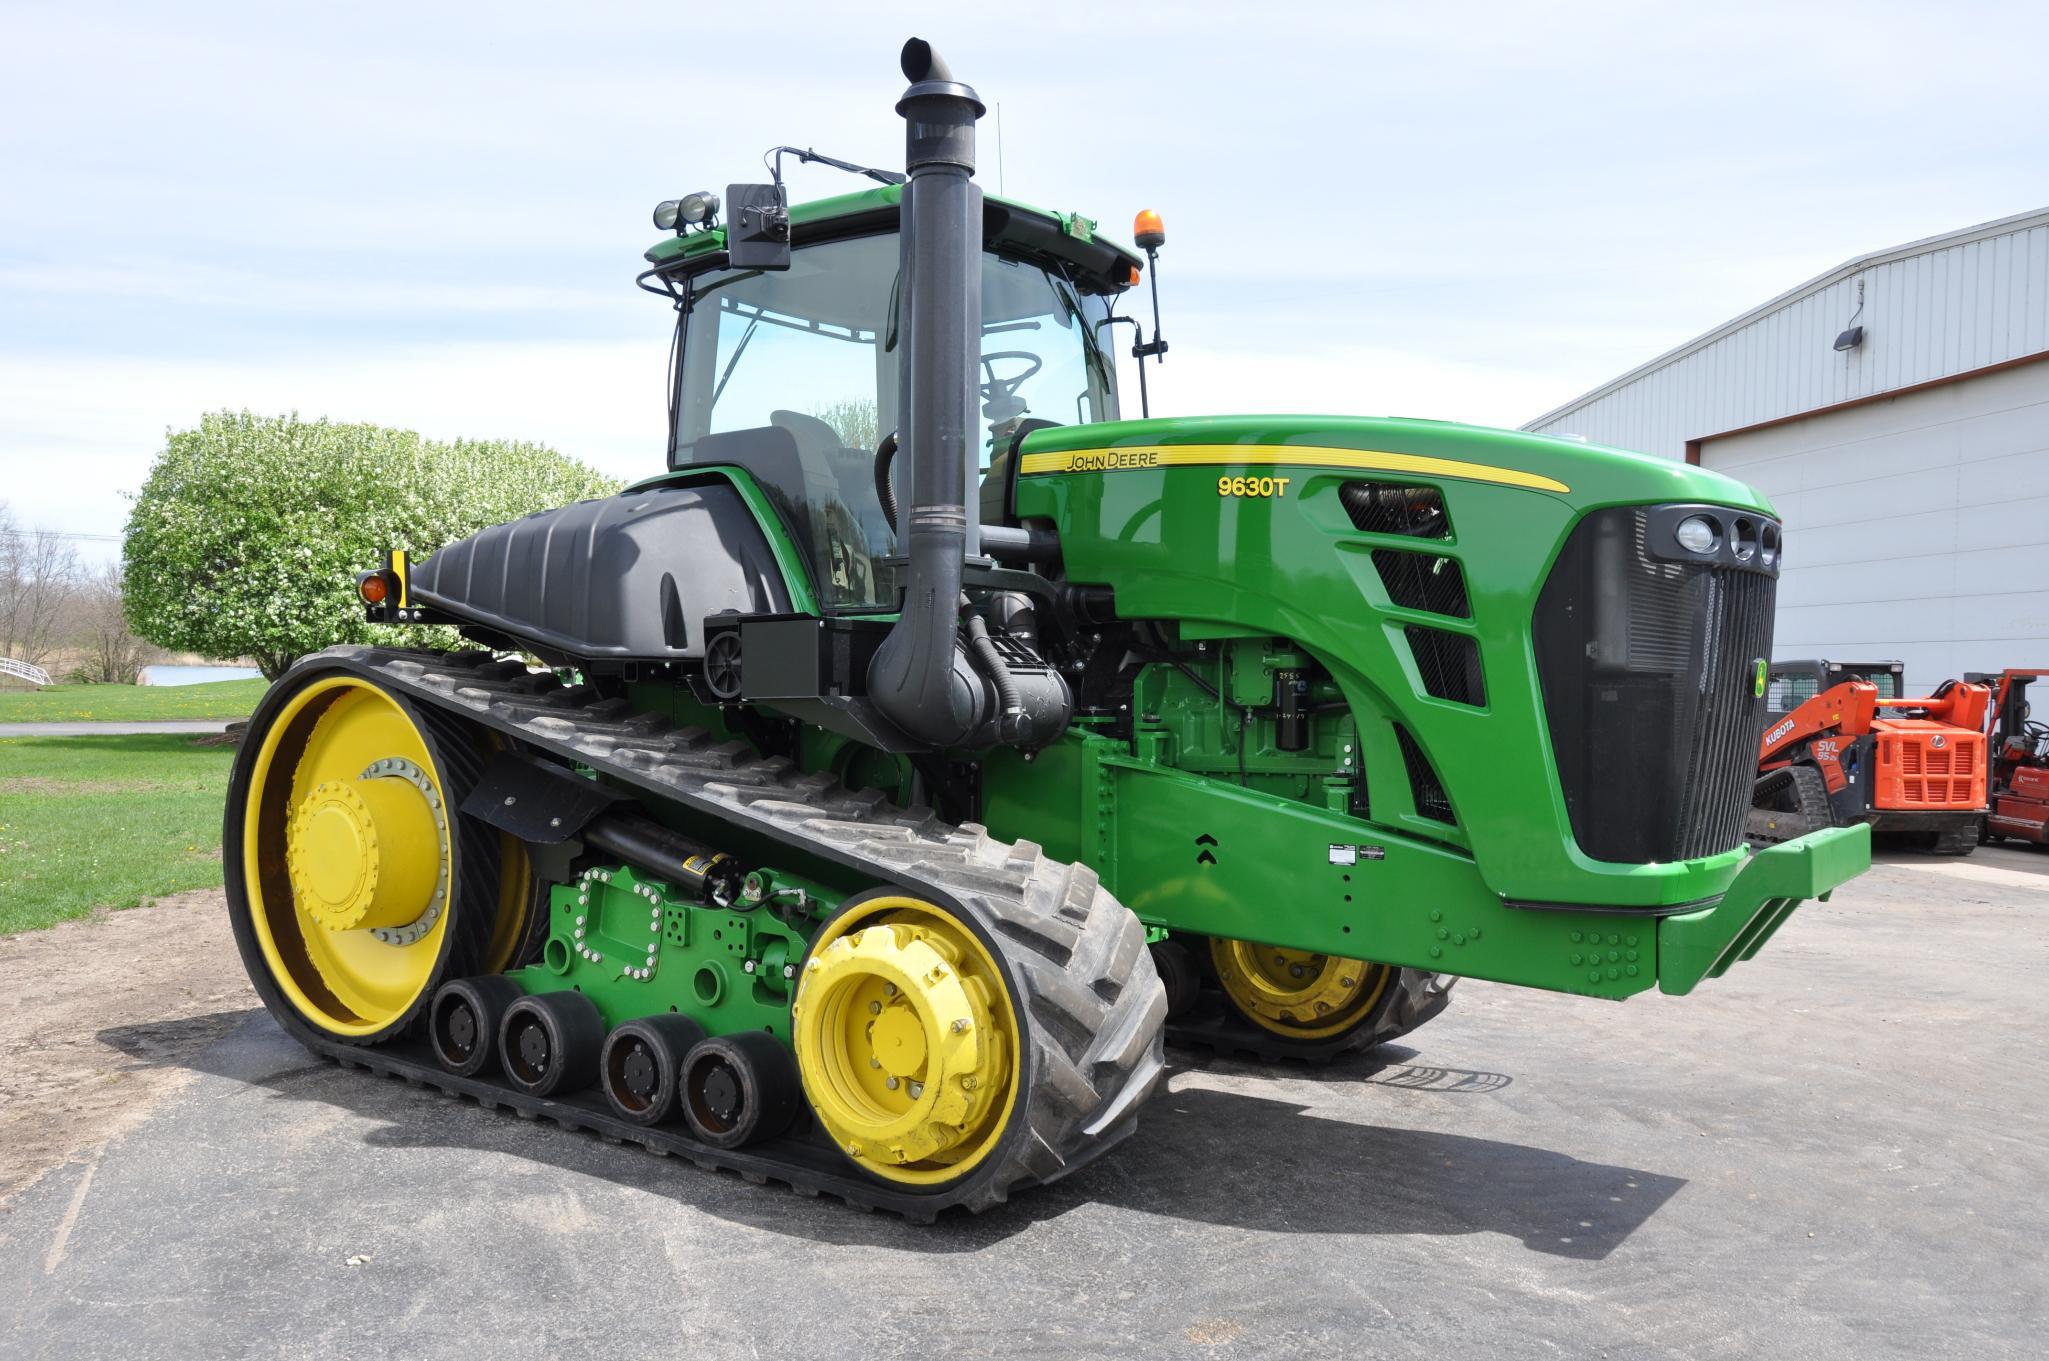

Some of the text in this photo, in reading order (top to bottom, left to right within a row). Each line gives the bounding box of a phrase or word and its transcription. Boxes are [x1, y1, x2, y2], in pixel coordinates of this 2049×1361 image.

[1067, 452, 1158, 469] JOHN DEERE
[1217, 476, 1290, 497] 9630T
[1765, 719, 1795, 746] KUBOTA
[1817, 740, 1839, 752] SVL
